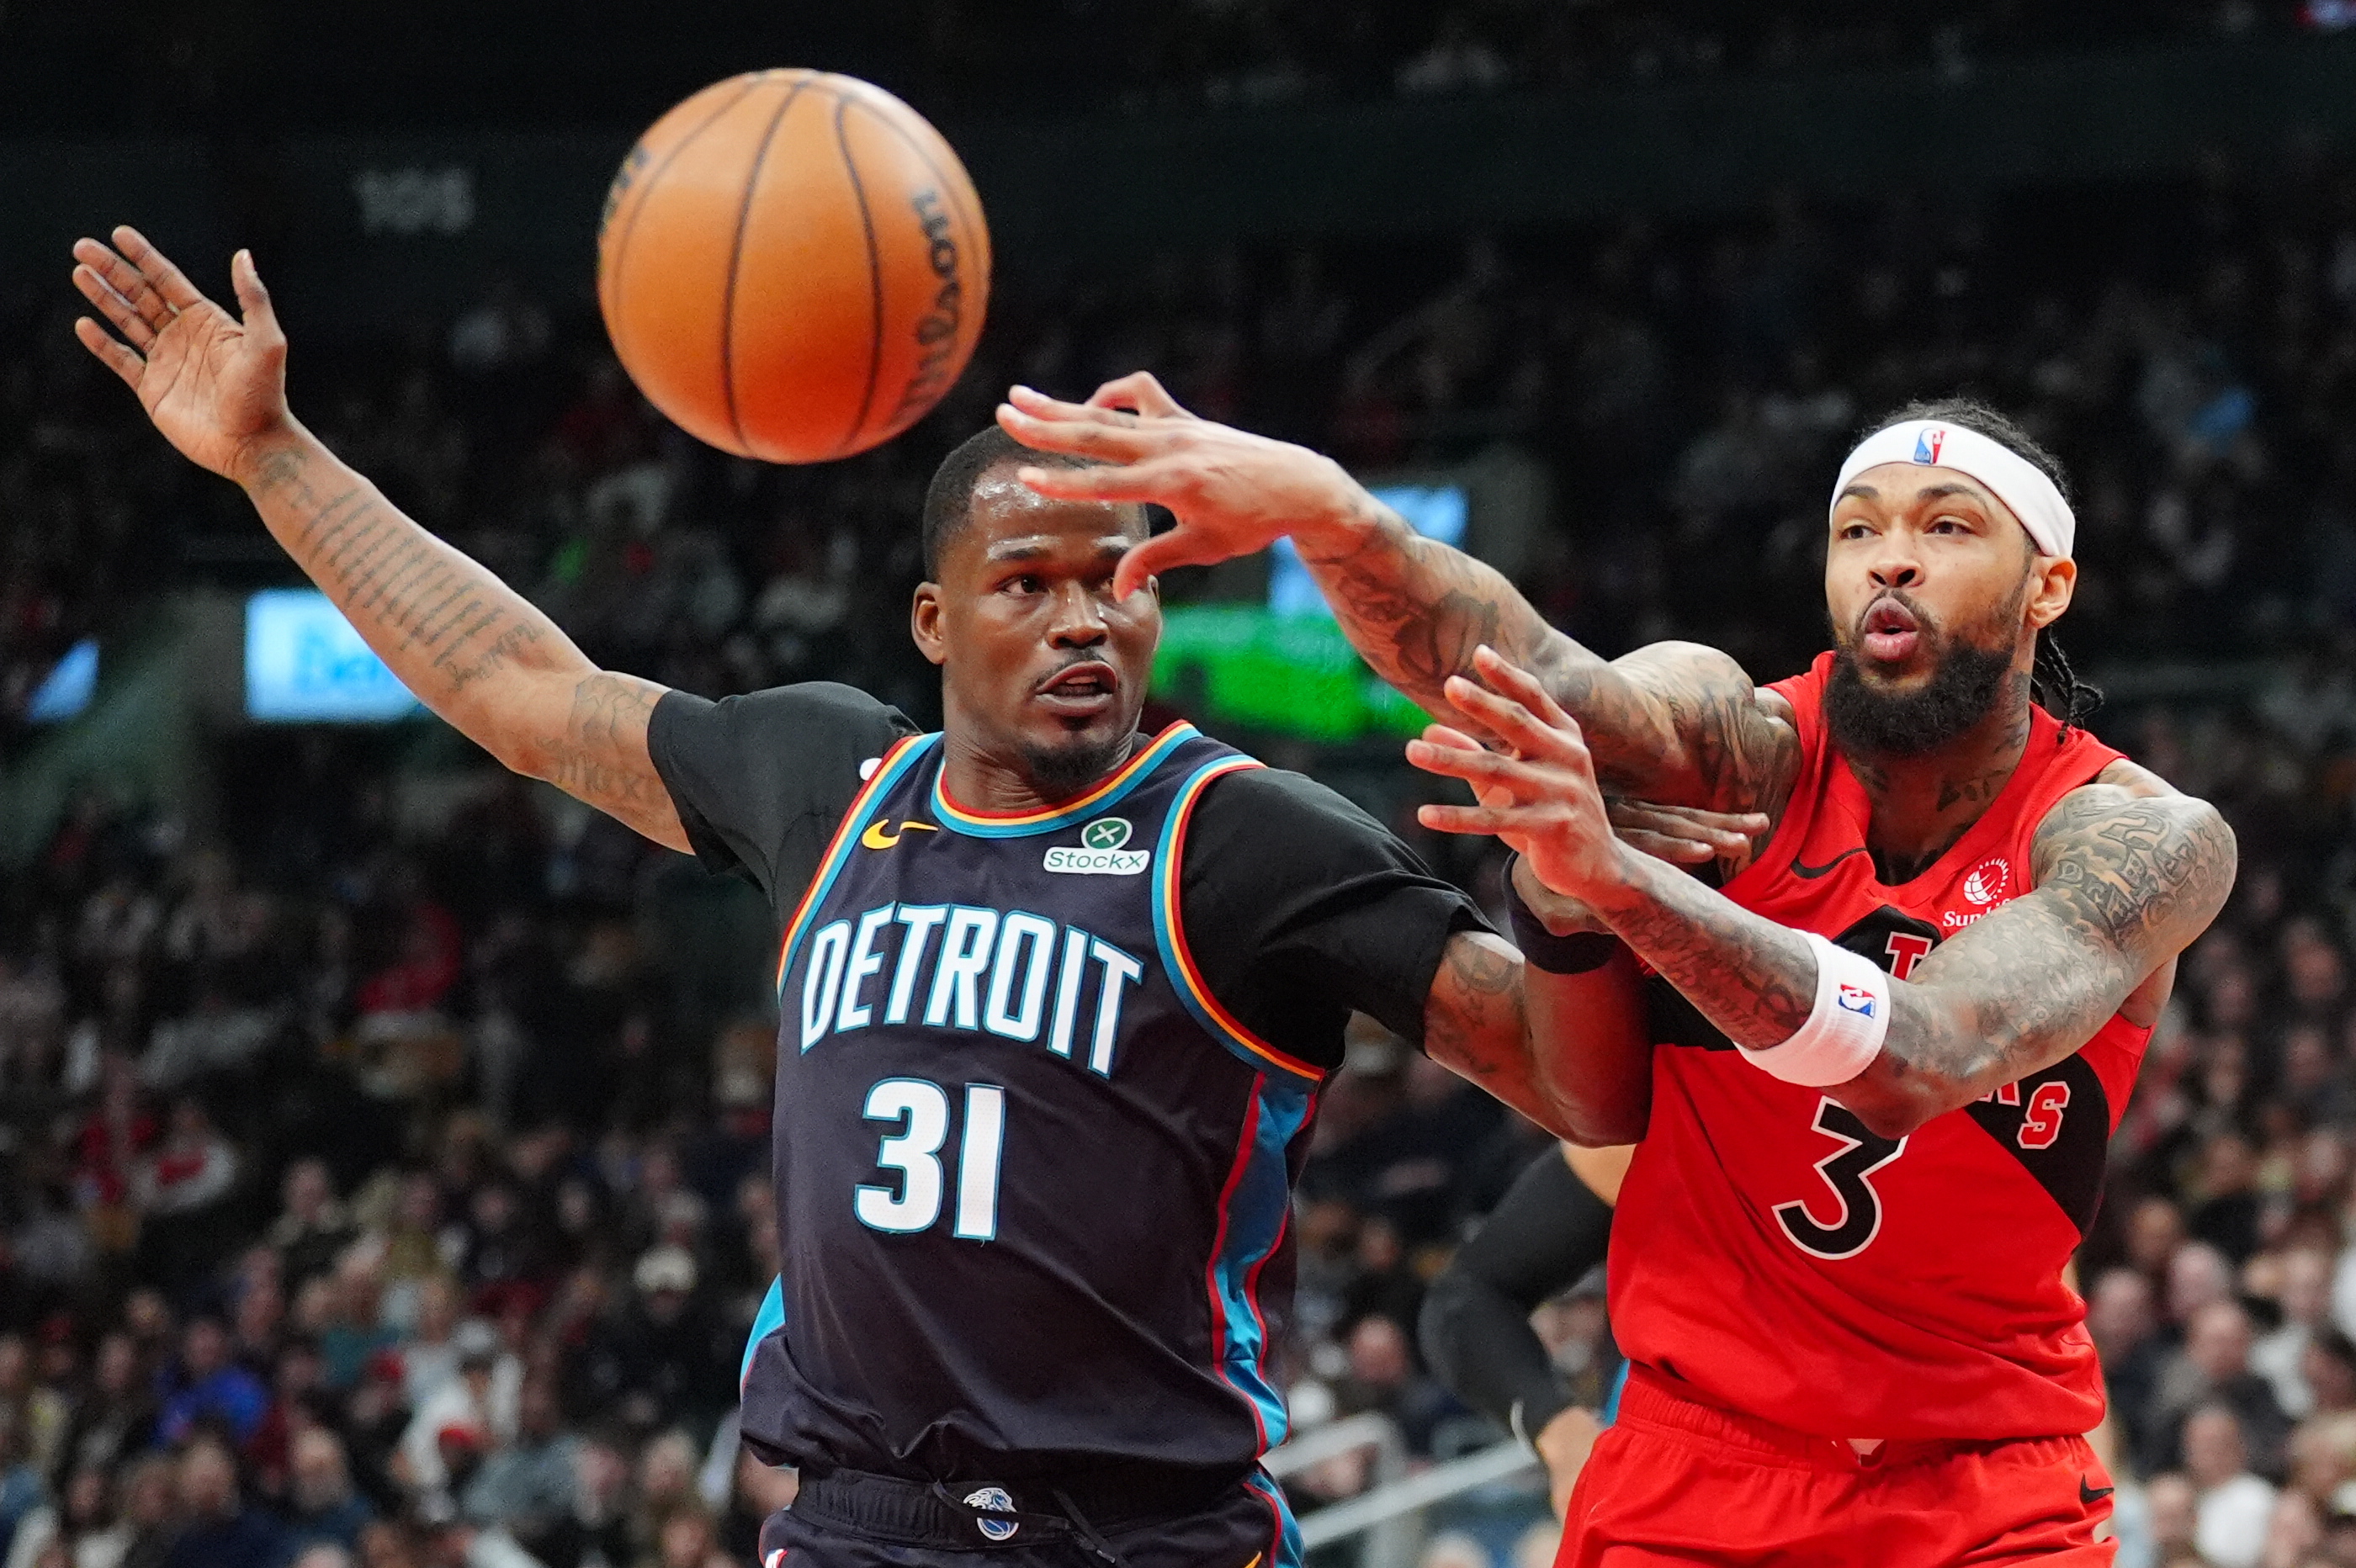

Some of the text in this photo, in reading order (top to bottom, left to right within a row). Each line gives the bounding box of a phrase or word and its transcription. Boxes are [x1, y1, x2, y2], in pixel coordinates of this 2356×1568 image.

[1048, 851, 1145, 870] StockX
[800, 900, 1144, 1079] DETROIT
[853, 1077, 1006, 1241] 31
[1771, 1095, 1909, 1260] 3
